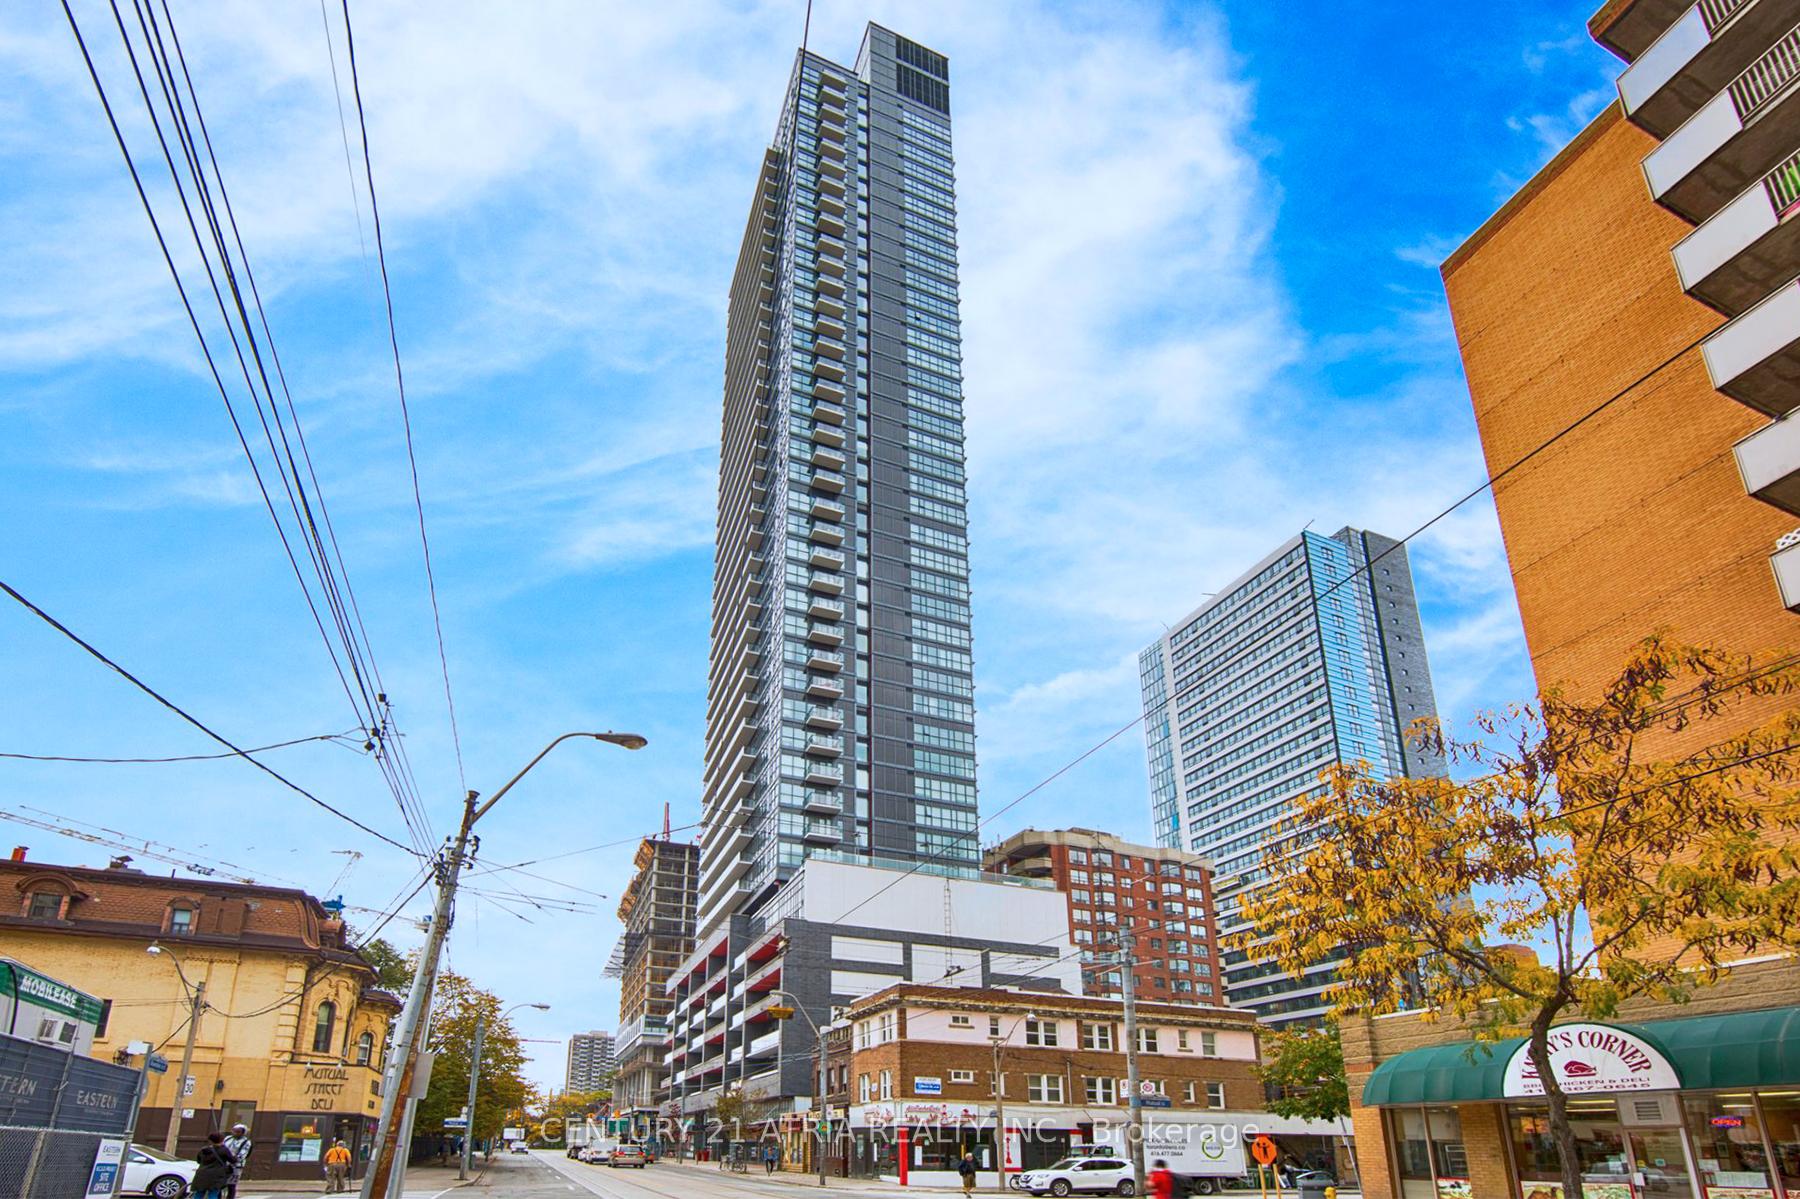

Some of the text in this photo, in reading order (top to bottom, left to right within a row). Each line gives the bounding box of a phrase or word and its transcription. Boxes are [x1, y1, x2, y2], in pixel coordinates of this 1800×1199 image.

[20, 975, 78, 1008] MOBILEASE
[1577, 1030, 1652, 1073] CORNER
[303, 1068, 349, 1080] MUTUAL
[0, 1074, 38, 1097] TERN
[304, 1082, 345, 1095] STREET
[1559, 1079, 1604, 1087] HICKEN
[76, 1090, 119, 1109] EASTERN
[310, 1098, 334, 1110] DELI
[1711, 1118, 1742, 1126] OPEN
